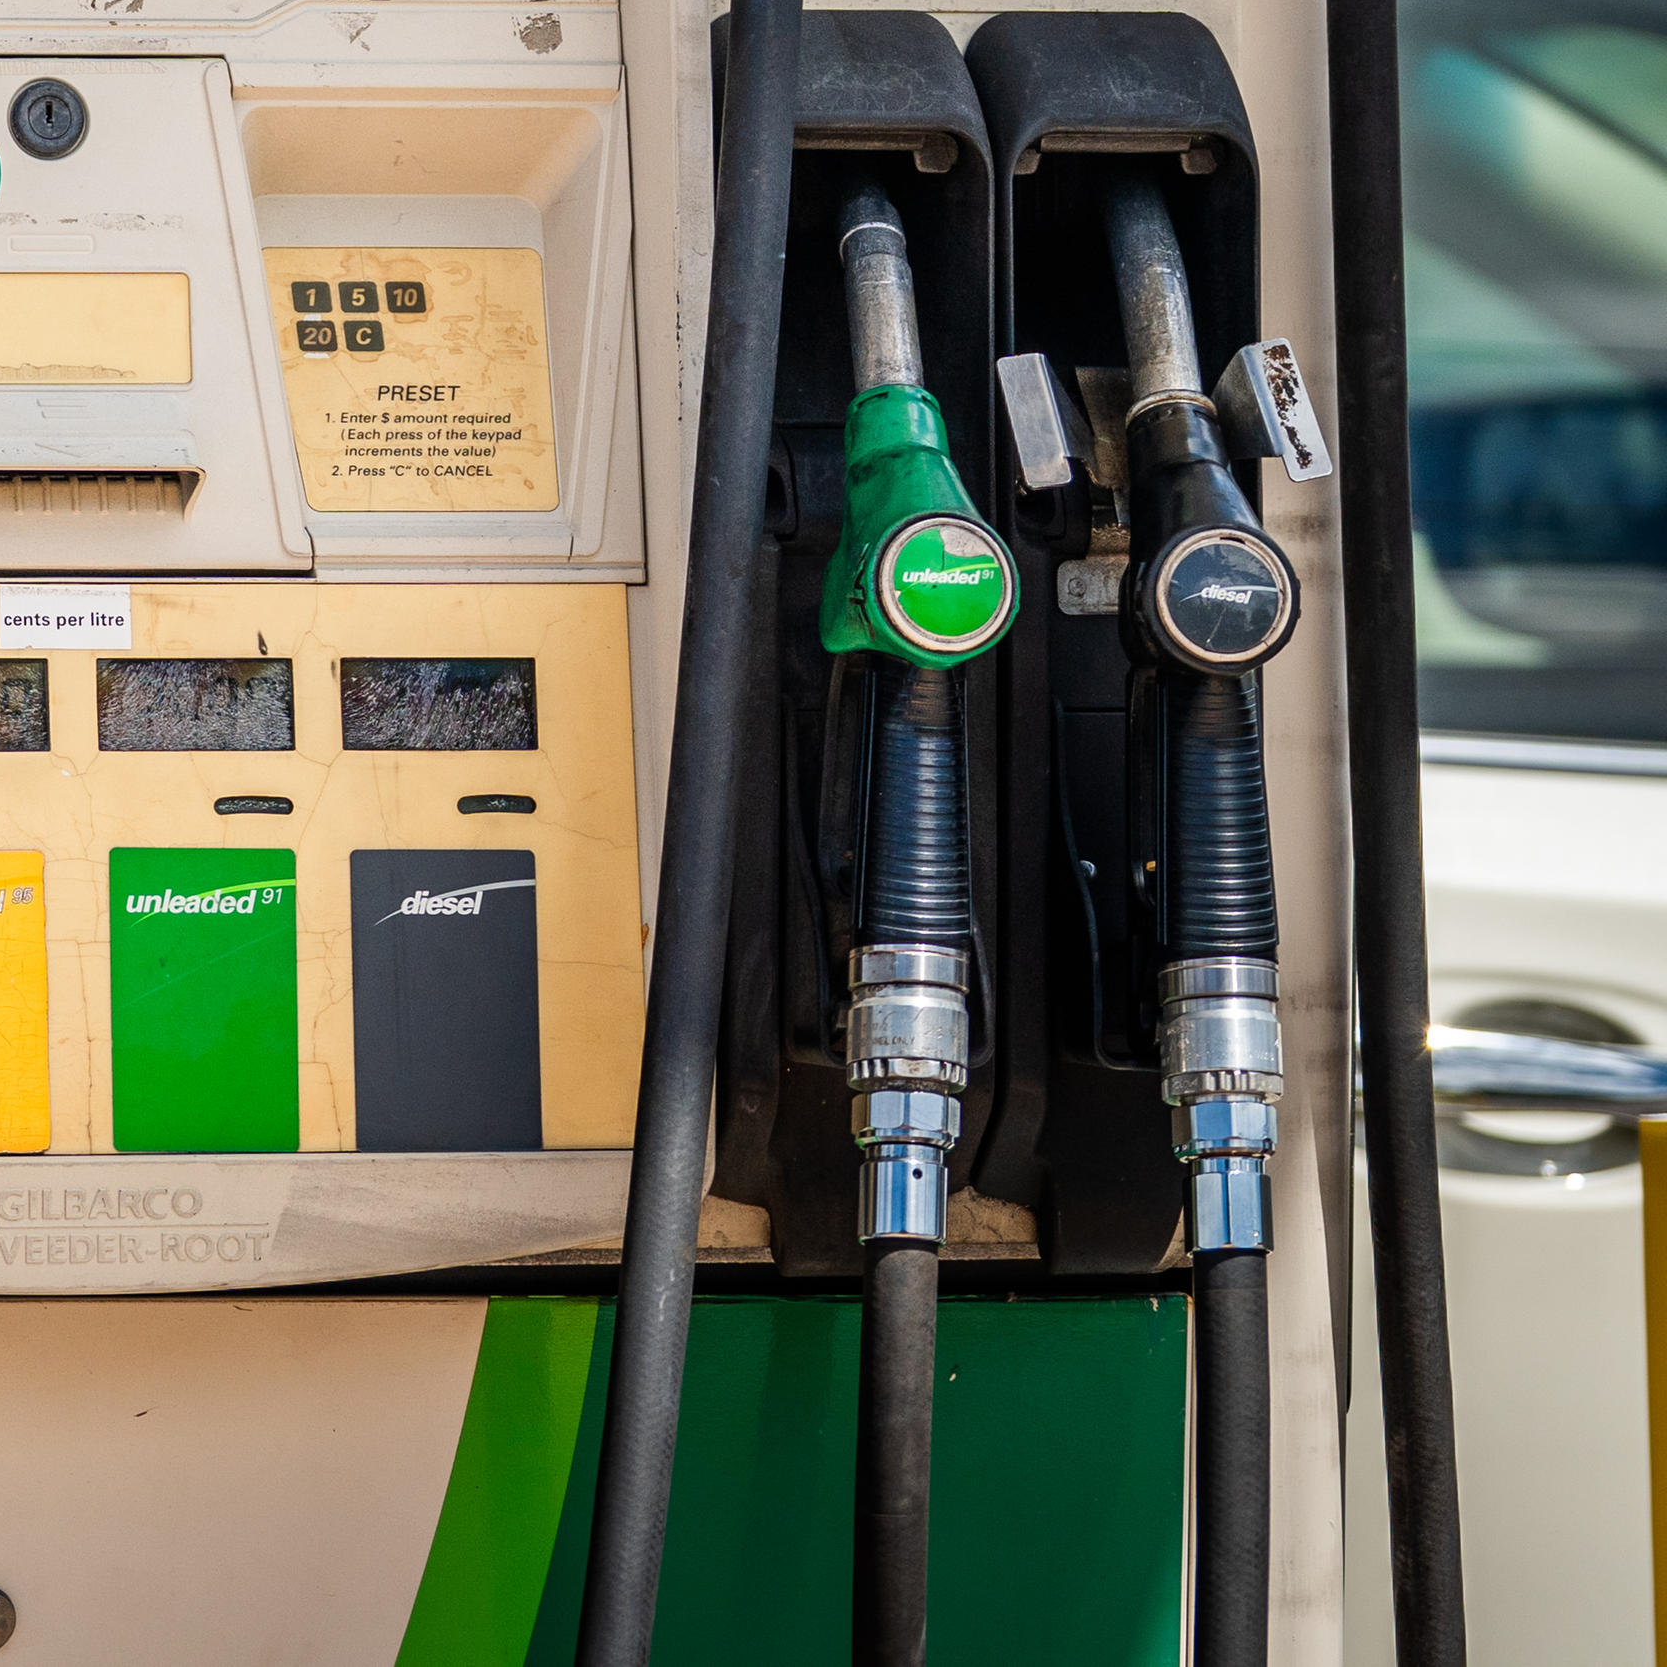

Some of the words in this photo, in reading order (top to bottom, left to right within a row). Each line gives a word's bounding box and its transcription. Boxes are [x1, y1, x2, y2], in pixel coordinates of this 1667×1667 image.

[306, 288, 316, 307] 1
[351, 288, 365, 307] 5
[393, 288, 418, 307] 10
[303, 327, 332, 345] 20
[355, 327, 372, 345] C
[378, 385, 461, 402] PRESET
[325, 413, 336, 423] 1.
[340, 413, 377, 424] Enter
[381, 412, 390, 424] $
[394, 413, 448, 424] amount
[452, 413, 512, 425] required
[385, 430, 423, 442] press
[427, 429, 442, 440] of
[446, 429, 468, 440] the
[472, 429, 522, 443] keypad
[345, 446, 423, 457] increments
[428, 446, 449, 456] the
[454, 446, 496, 458] value)
[331, 465, 343, 476] 2.
[348, 465, 386, 476] Press
[416, 466, 429, 476] to
[434, 465, 493, 477] CANCEL
[902, 567, 981, 585] unleaded
[981, 569, 995, 580] 91
[1200, 583, 1253, 605] diesel
[4, 613, 51, 627] cents
[56, 615, 84, 630] per
[90, 612, 124, 627] litre
[11, 887, 34, 904] 95
[126, 889, 257, 914] unleaded
[261, 888, 283, 904] 91
[400, 890, 483, 916] diesel
